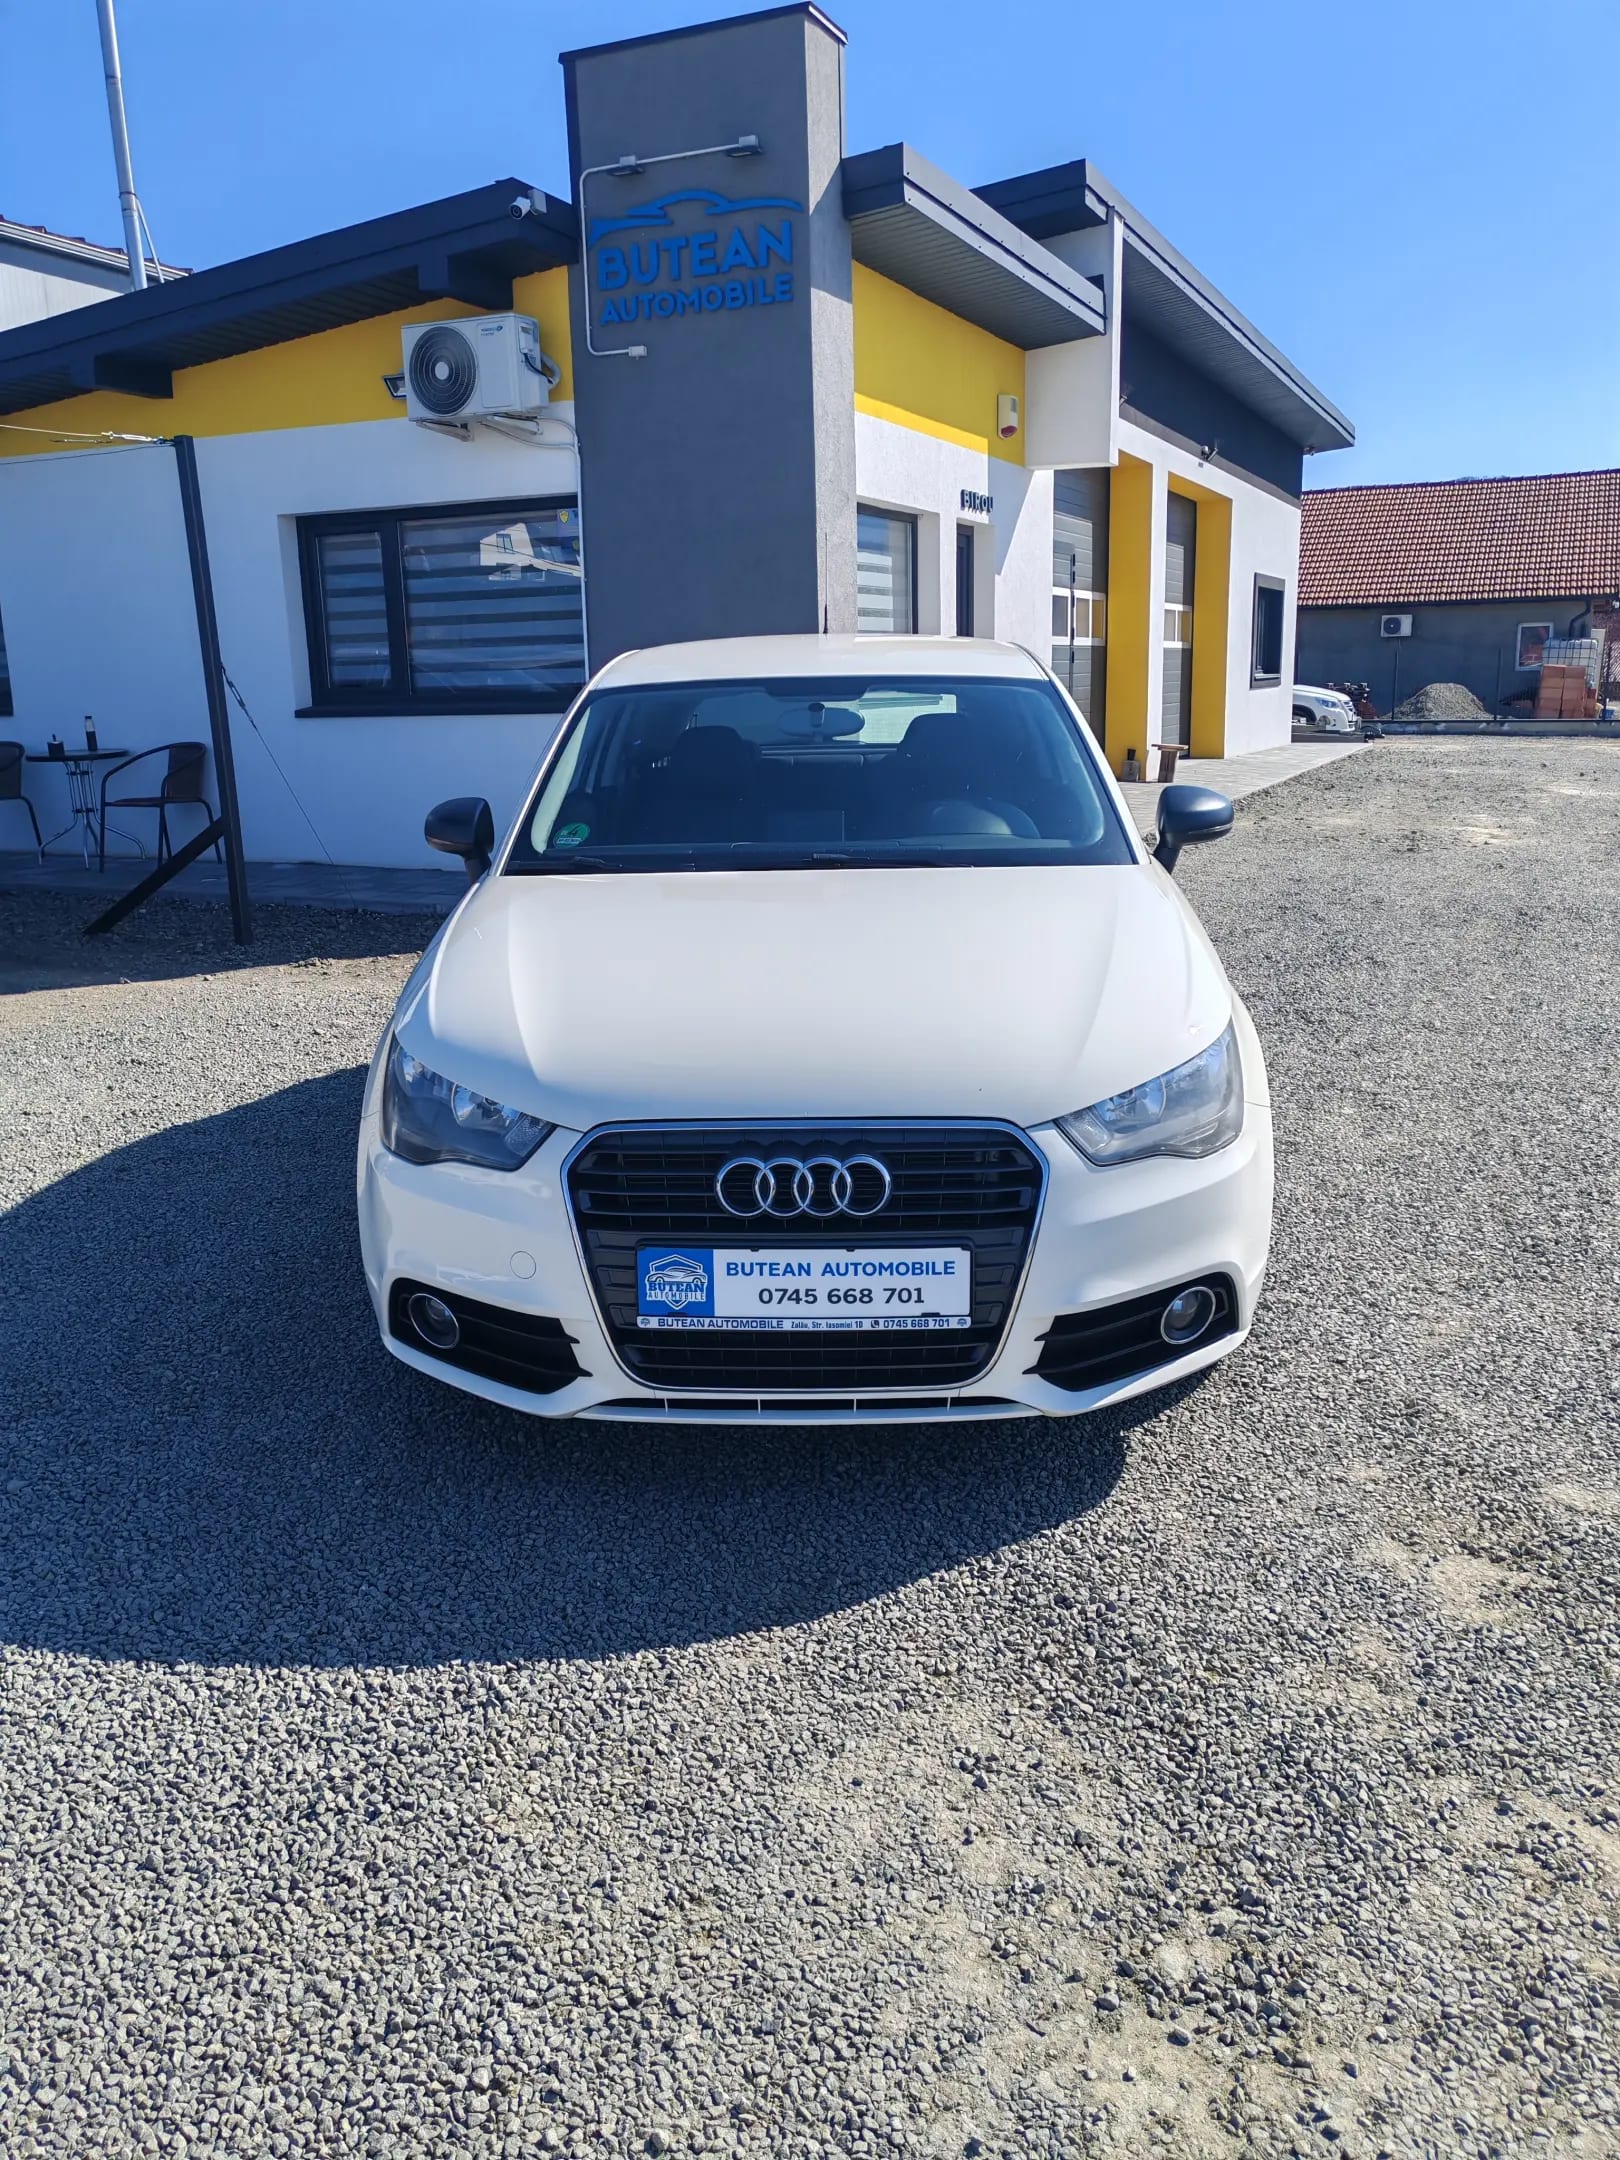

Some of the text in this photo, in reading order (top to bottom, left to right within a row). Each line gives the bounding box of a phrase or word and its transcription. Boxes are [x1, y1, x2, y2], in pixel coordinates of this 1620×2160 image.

[599, 221, 793, 290] BUTEAN
[600, 273, 793, 325] AUTOMOBILE
[961, 489, 993, 513] BIROU
[727, 1261, 955, 1277] BUTEAN AUTOMOBILE
[648, 1282, 705, 1292] BUTEAN
[648, 1292, 705, 1300] AUTOMOBILE
[758, 1288, 925, 1304] 0745 668 701
[658, 1318, 705, 1328] BUTEAN
[708, 1319, 784, 1329] AUTOMOBILE
[883, 1319, 908, 1328] 0745
[910, 1319, 930, 1328] 668
[932, 1318, 950, 1327] 701
